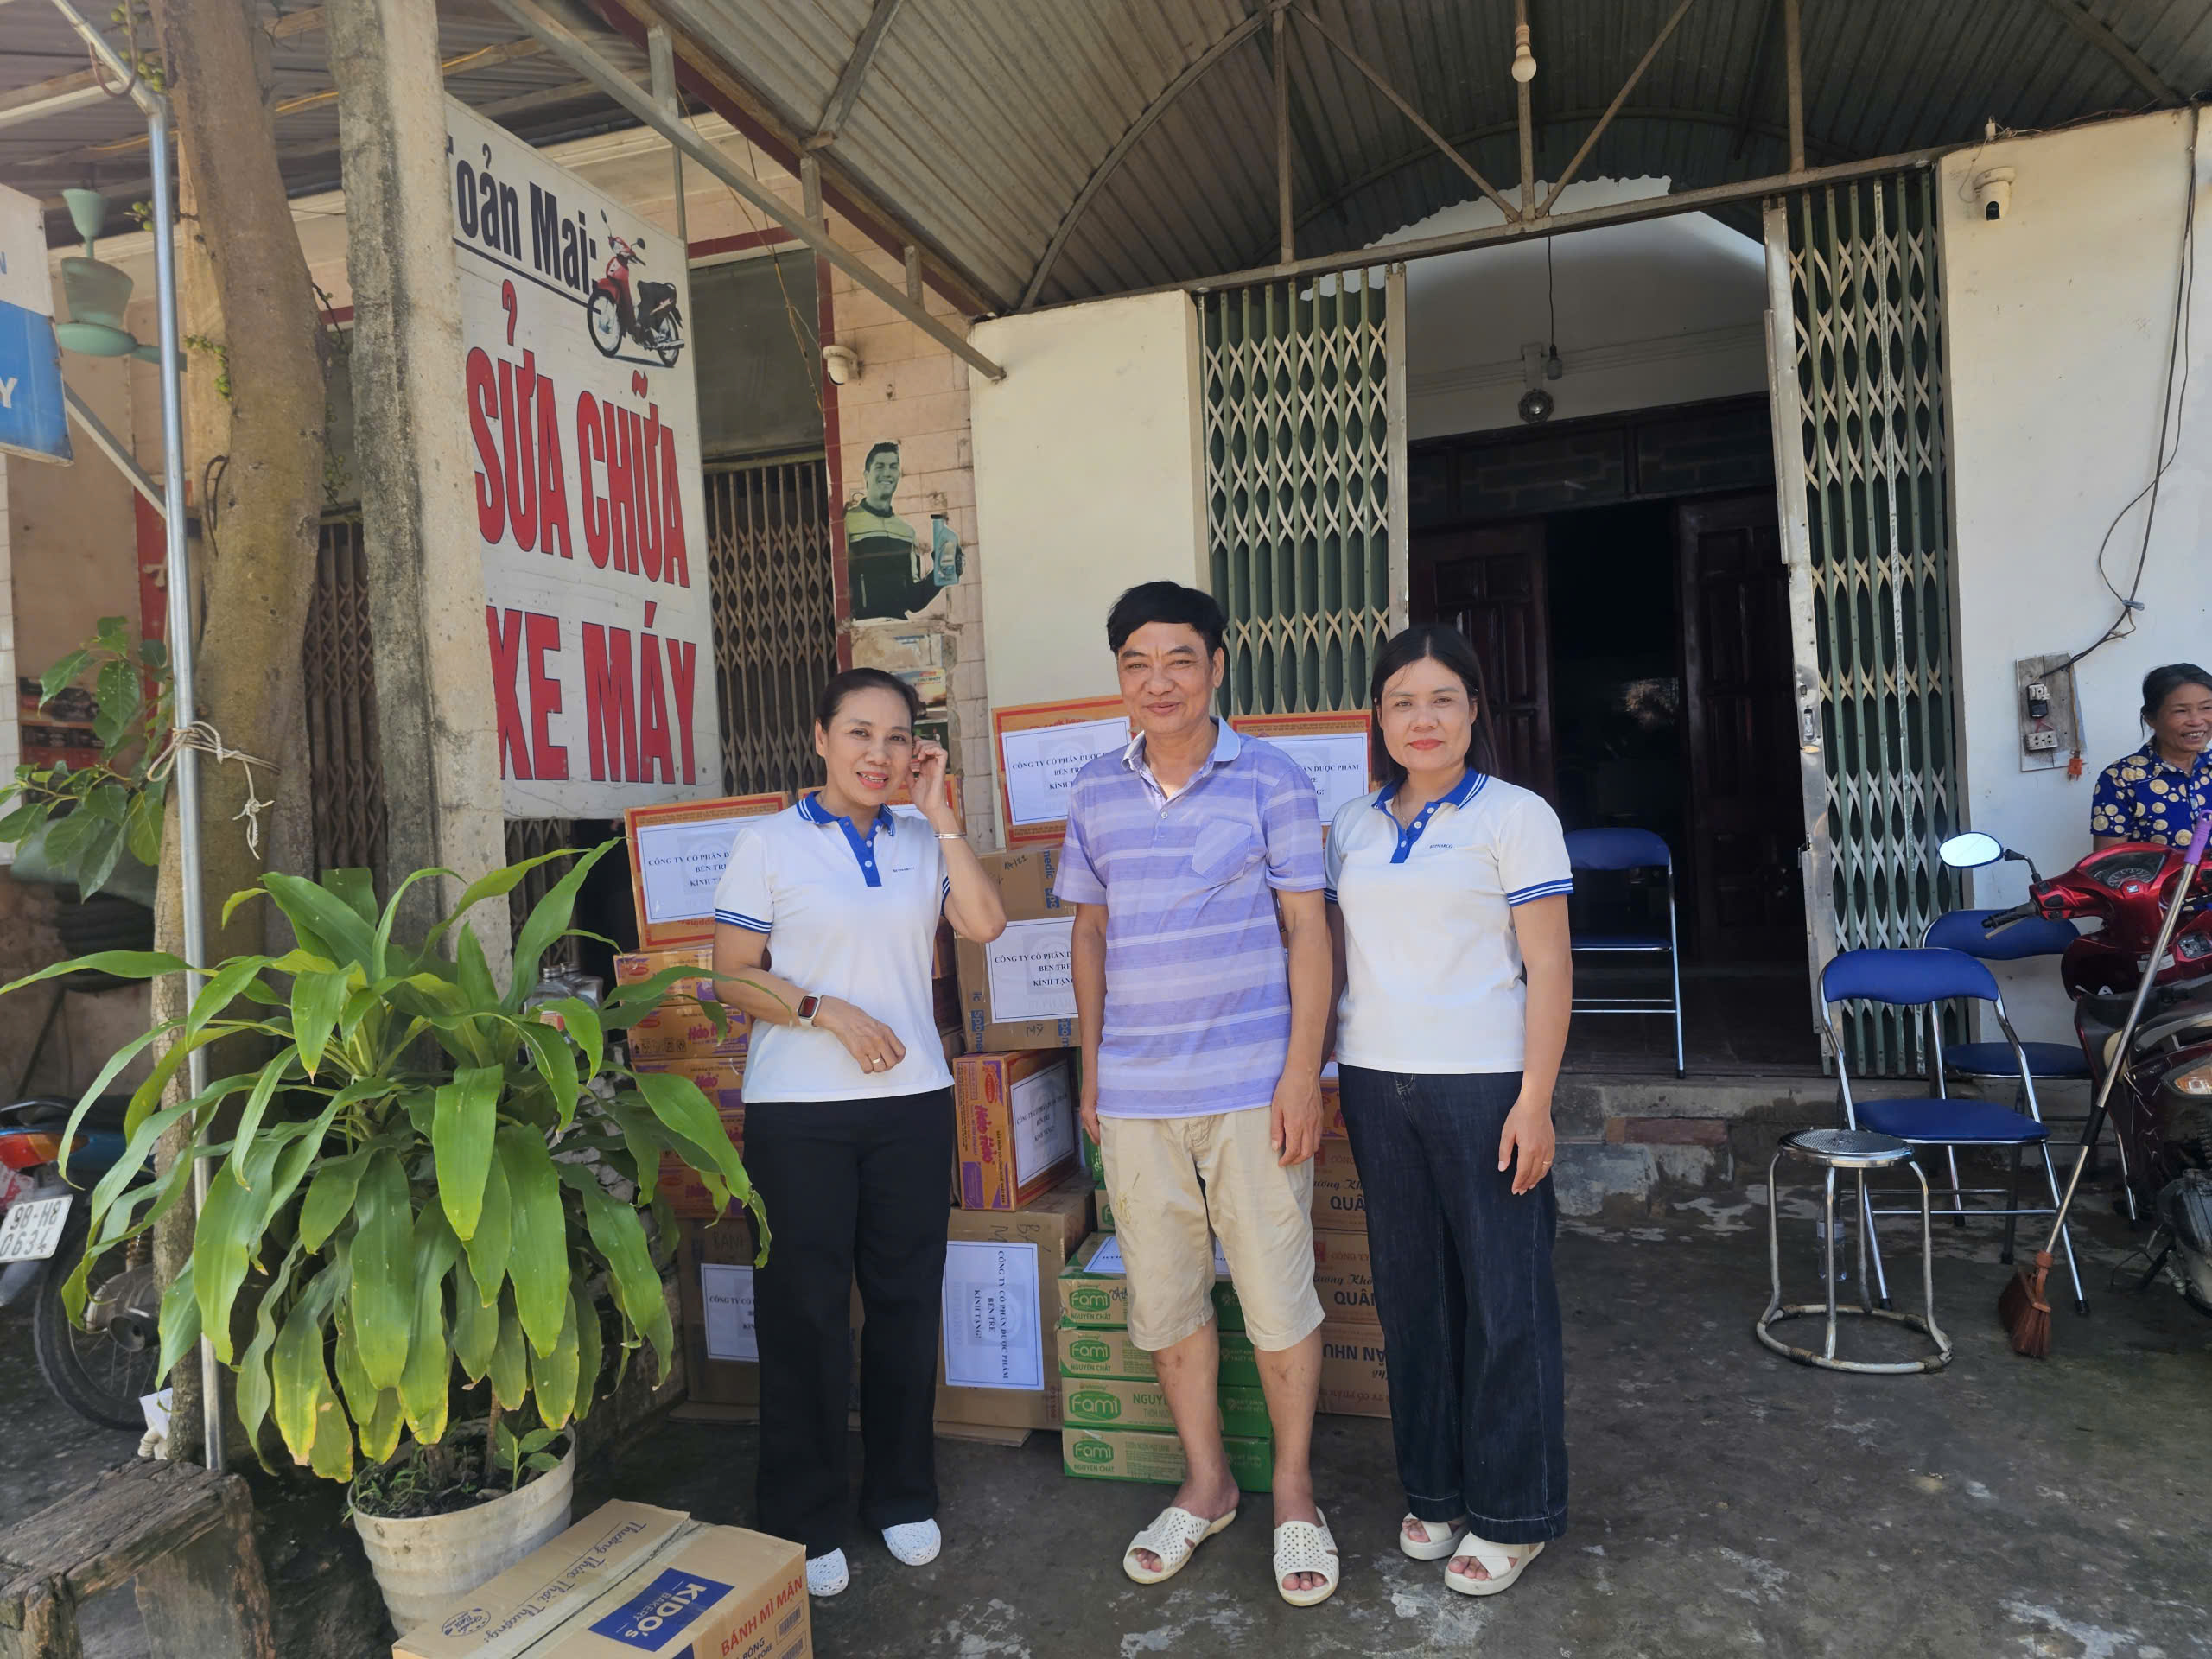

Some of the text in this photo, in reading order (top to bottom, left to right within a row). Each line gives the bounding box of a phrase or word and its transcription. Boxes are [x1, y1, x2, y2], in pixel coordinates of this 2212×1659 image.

[446, 135, 522, 261] oản
[466, 279, 690, 588] SỬA CHỮA
[486, 601, 696, 785] XE MÁY
[1013, 760, 1033, 770] CÔNG
[1314, 765, 1338, 773] DƯỢC
[648, 855, 672, 866] CÔNG
[995, 952, 1017, 963] CÔNG
[1043, 950, 1065, 960] PHẦN
[1033, 977, 1053, 987] KÍNH
[1331, 1193, 1365, 1211] QUÂ
[632, 1592, 672, 1621] BAKERY
[721, 1575, 804, 1657] BÁNH MÌ MẶN
